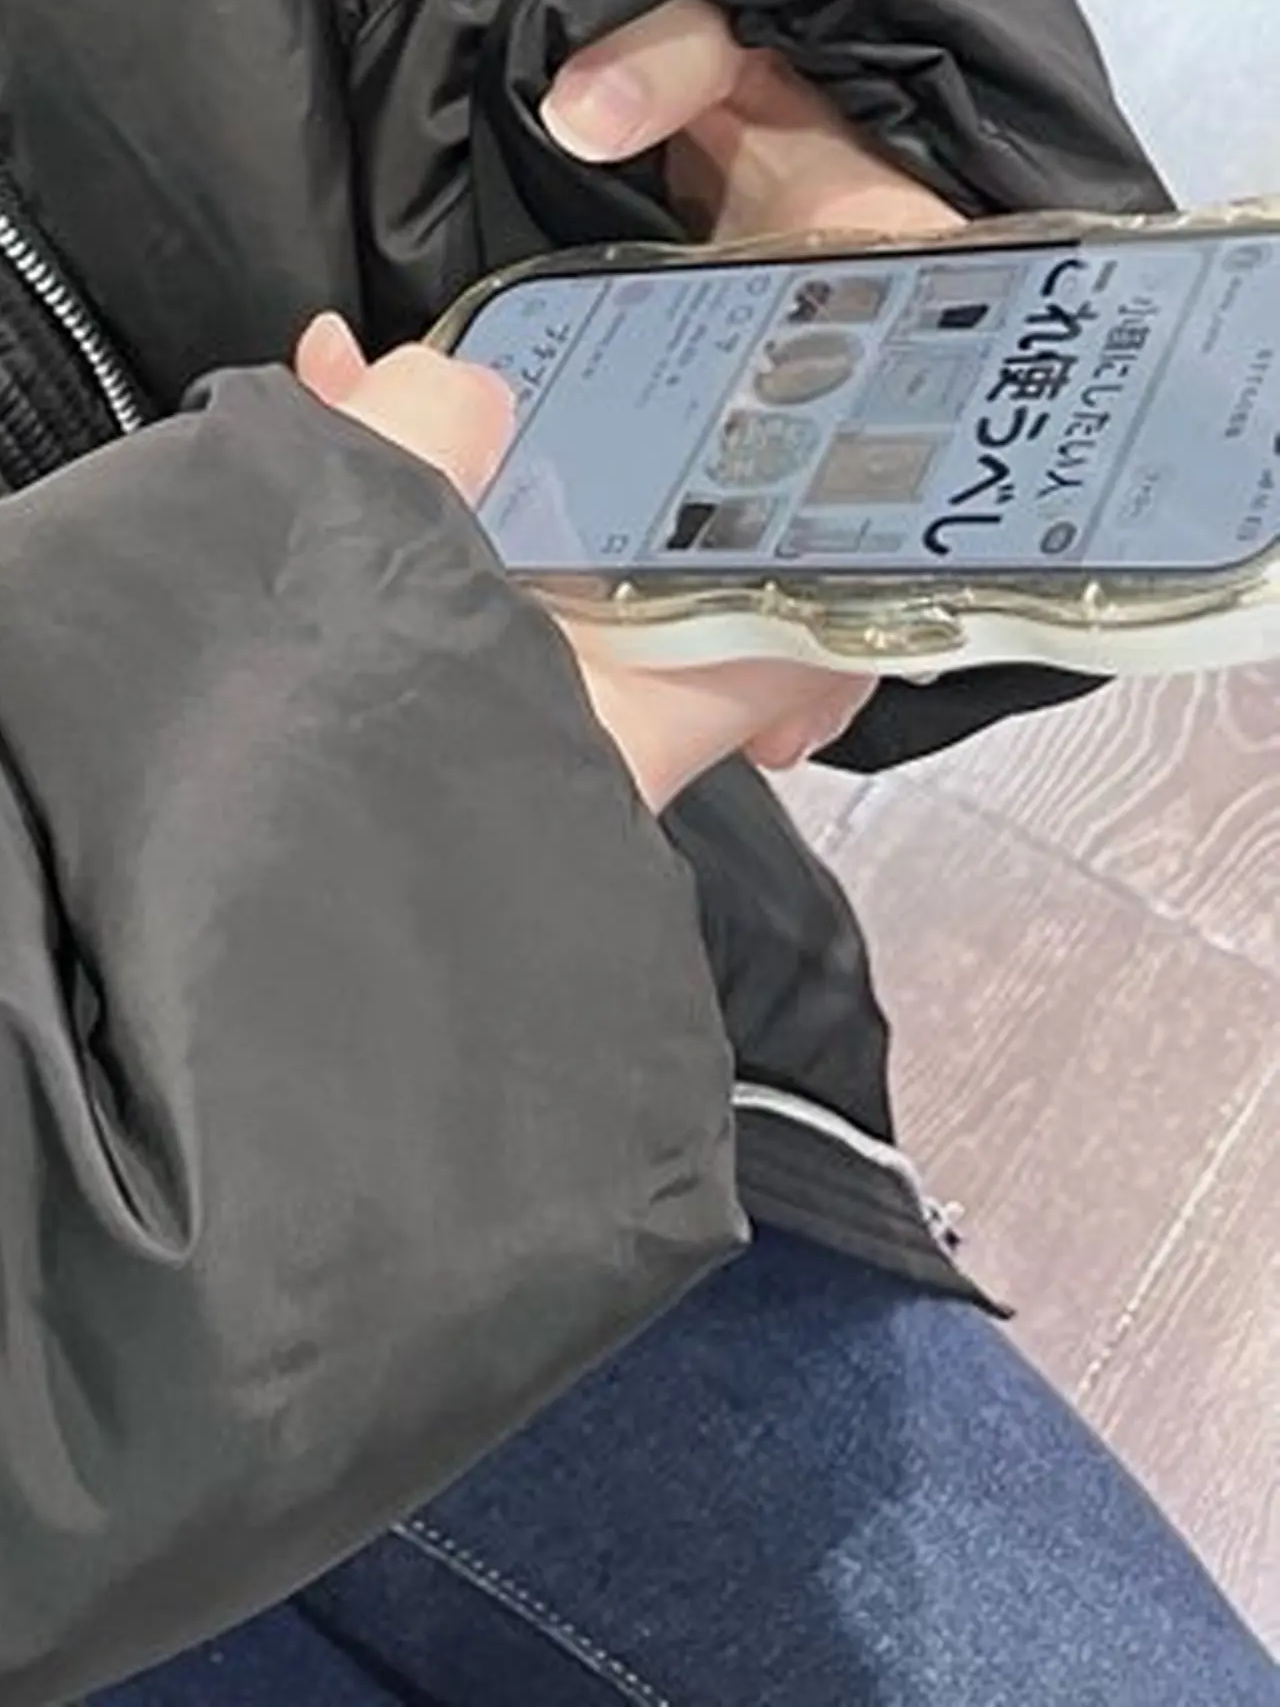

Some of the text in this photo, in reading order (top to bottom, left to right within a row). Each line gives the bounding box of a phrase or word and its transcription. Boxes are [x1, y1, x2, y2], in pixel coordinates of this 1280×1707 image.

[921, 258, 1117, 555] これ使うべし
